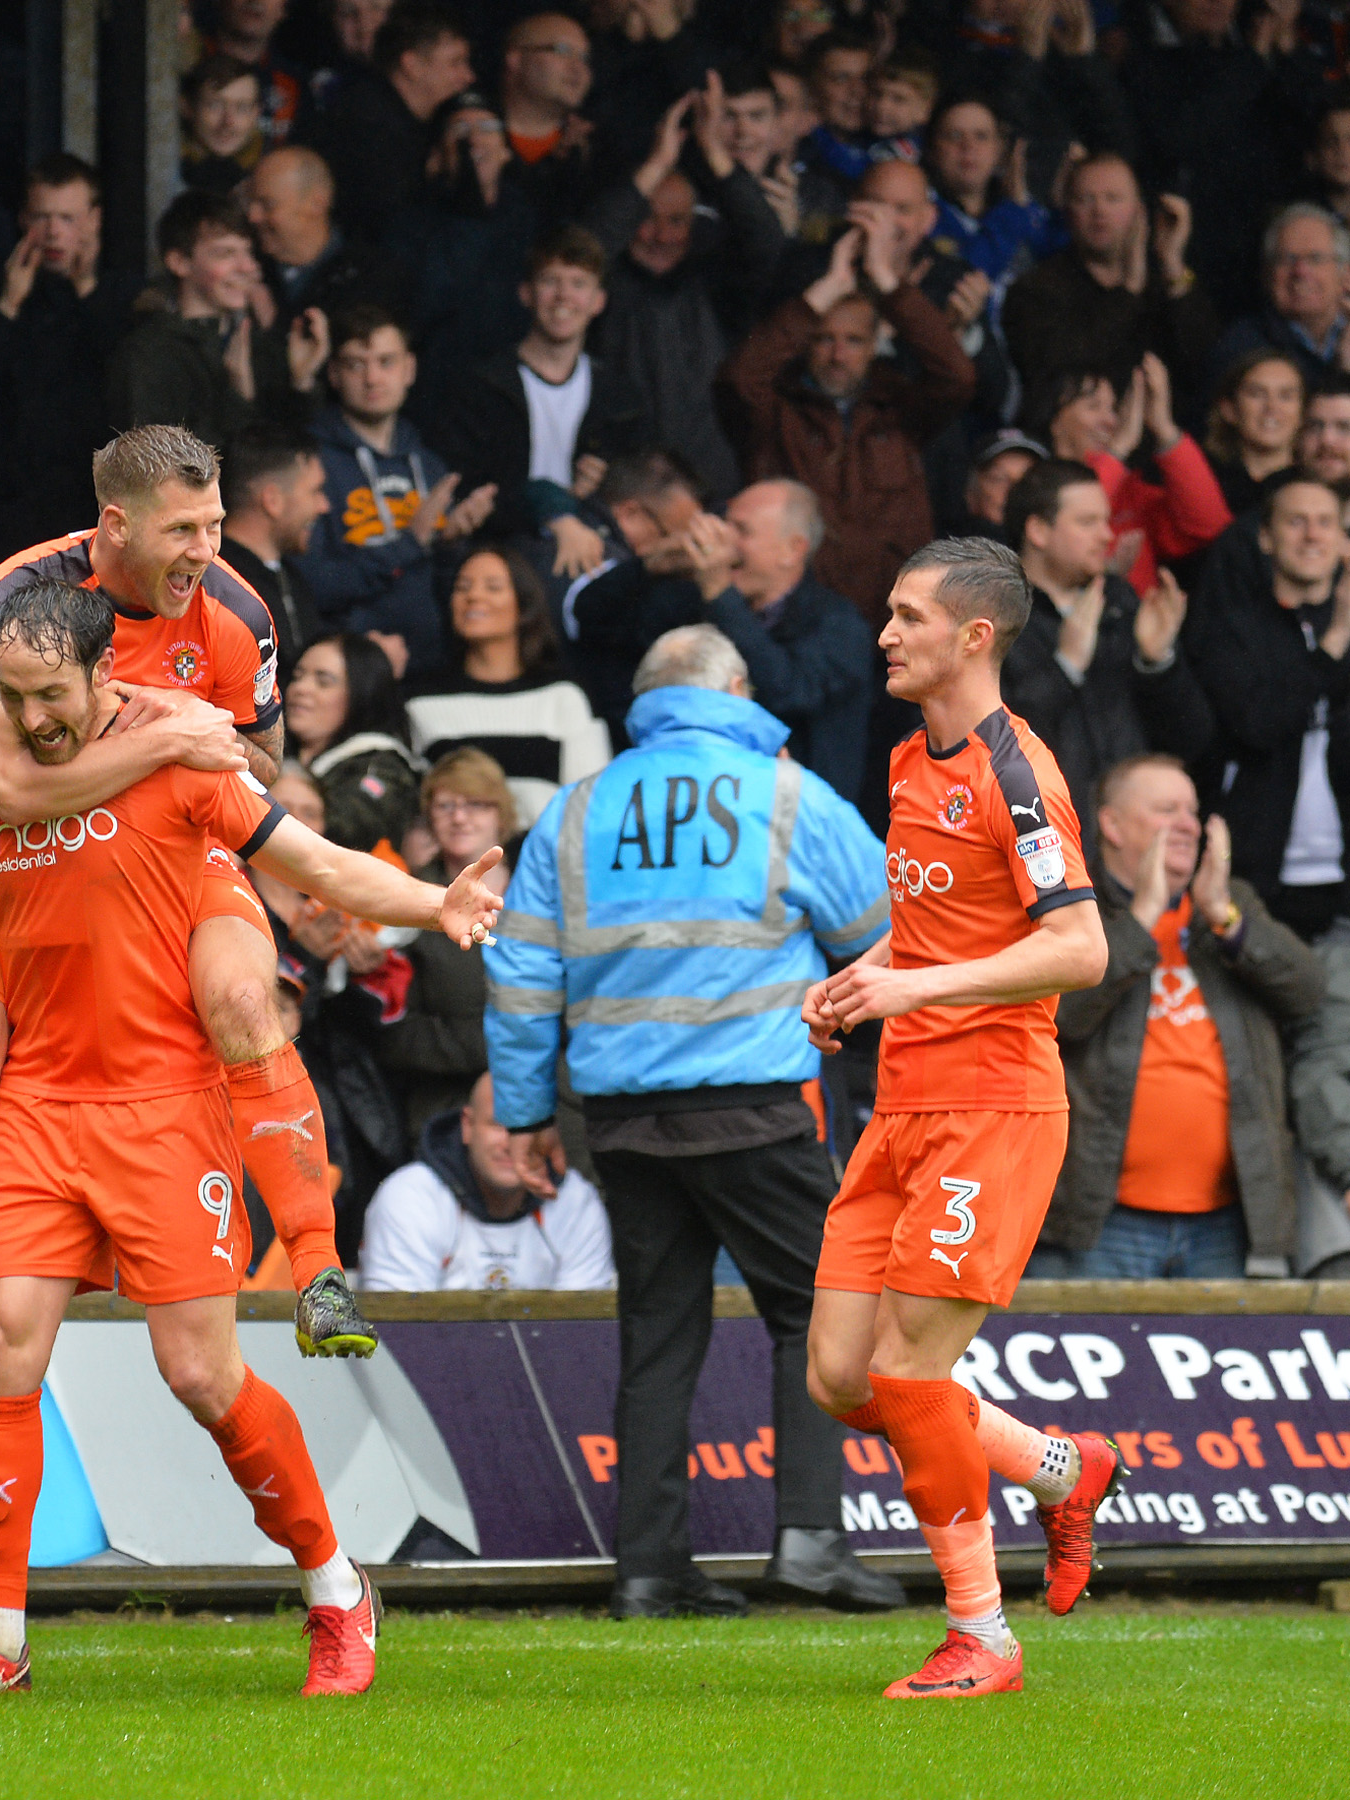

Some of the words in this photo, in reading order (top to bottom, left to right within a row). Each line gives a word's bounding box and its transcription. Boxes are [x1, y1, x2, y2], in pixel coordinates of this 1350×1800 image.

[165, 640, 186, 656] LUTON
[187, 641, 205, 656] TOWN
[611, 773, 740, 871] APS
[197, 1170, 233, 1240] 9
[930, 1176, 981, 1245] 3
[951, 1331, 1125, 1401] RCP
[578, 1426, 776, 1482] Pud
[1196, 1417, 1266, 1469] of
[1001, 1485, 1207, 1534] Pking
[1213, 1487, 1269, 1524] at
